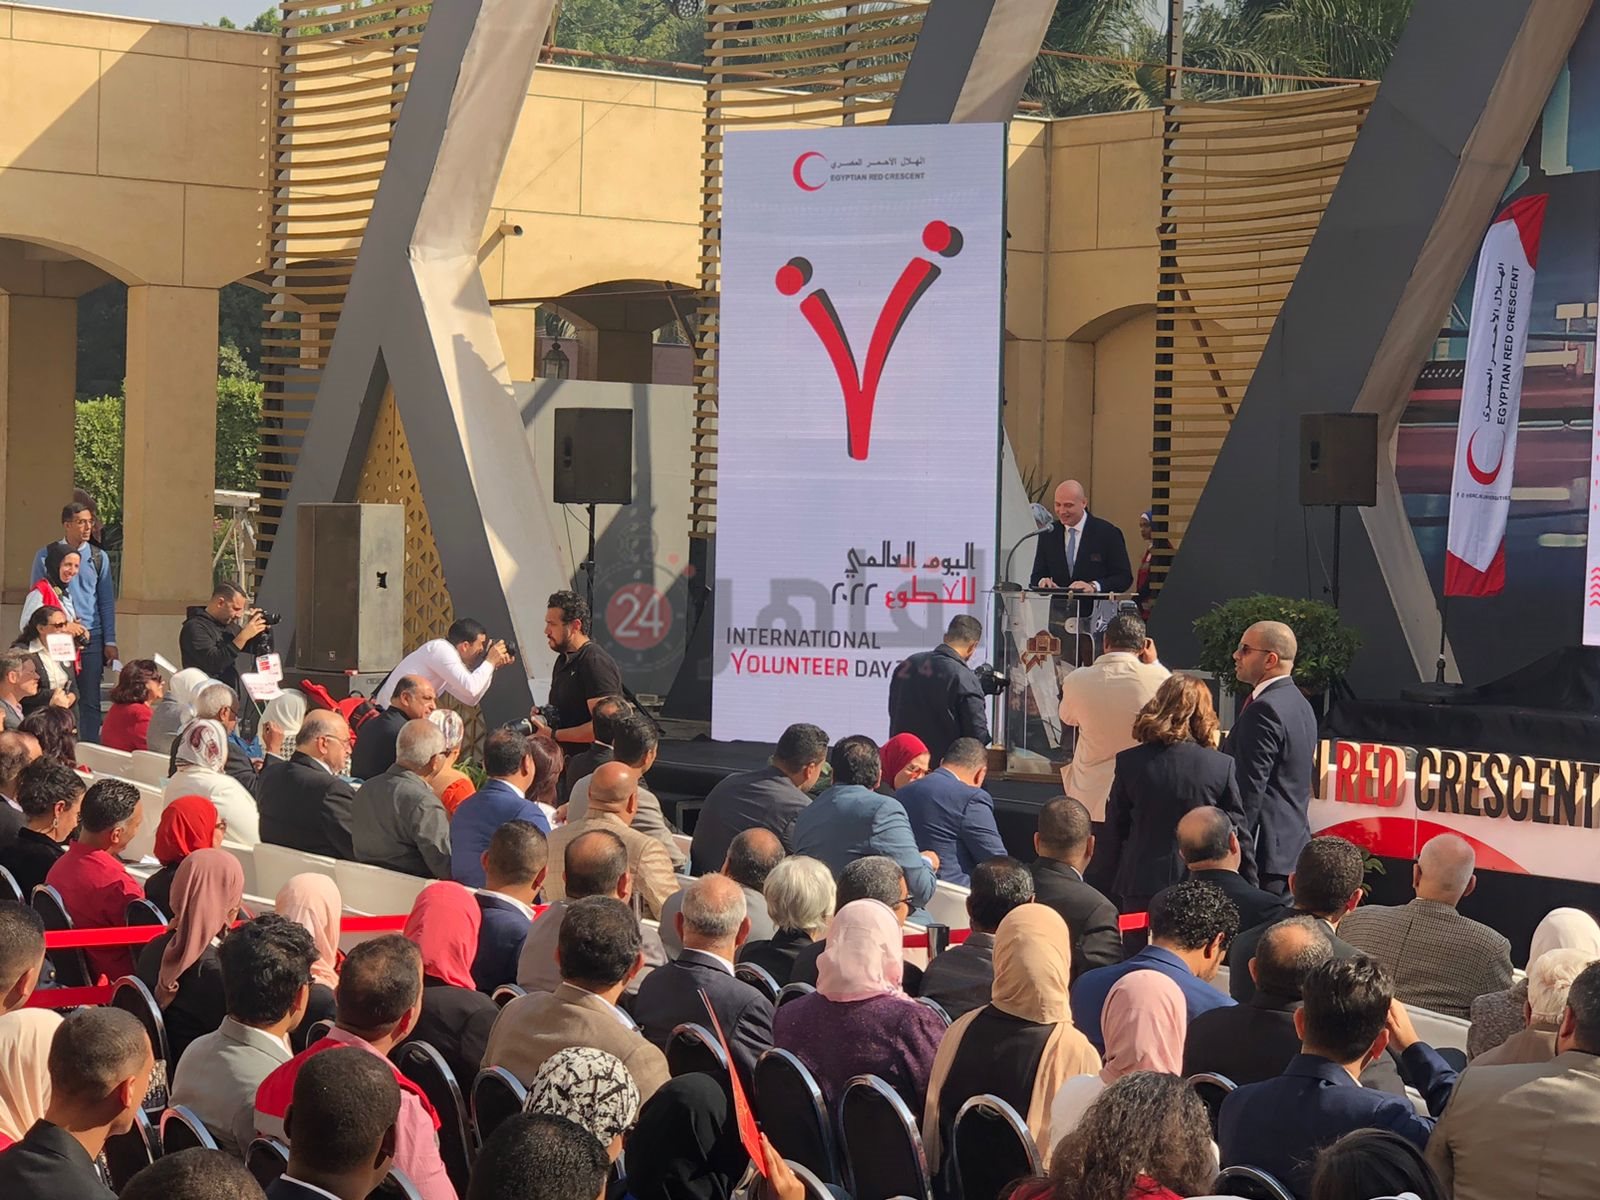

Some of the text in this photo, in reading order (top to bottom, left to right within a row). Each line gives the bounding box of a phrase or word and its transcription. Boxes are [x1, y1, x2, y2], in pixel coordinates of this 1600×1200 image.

[830, 173, 867, 181] EGYPTIAN
[885, 172, 925, 180] CRESCENT
[1497, 265, 1520, 425] EGYPTIAN RED CRESCENT
[844, 540, 975, 579] اليوم العالمي
[726, 627, 880, 649] INTERNATIONAL
[731, 648, 891, 678] VOLUNTEER DAY
[1335, 741, 1400, 807] RED
[1415, 748, 1600, 829] CRESCENT
